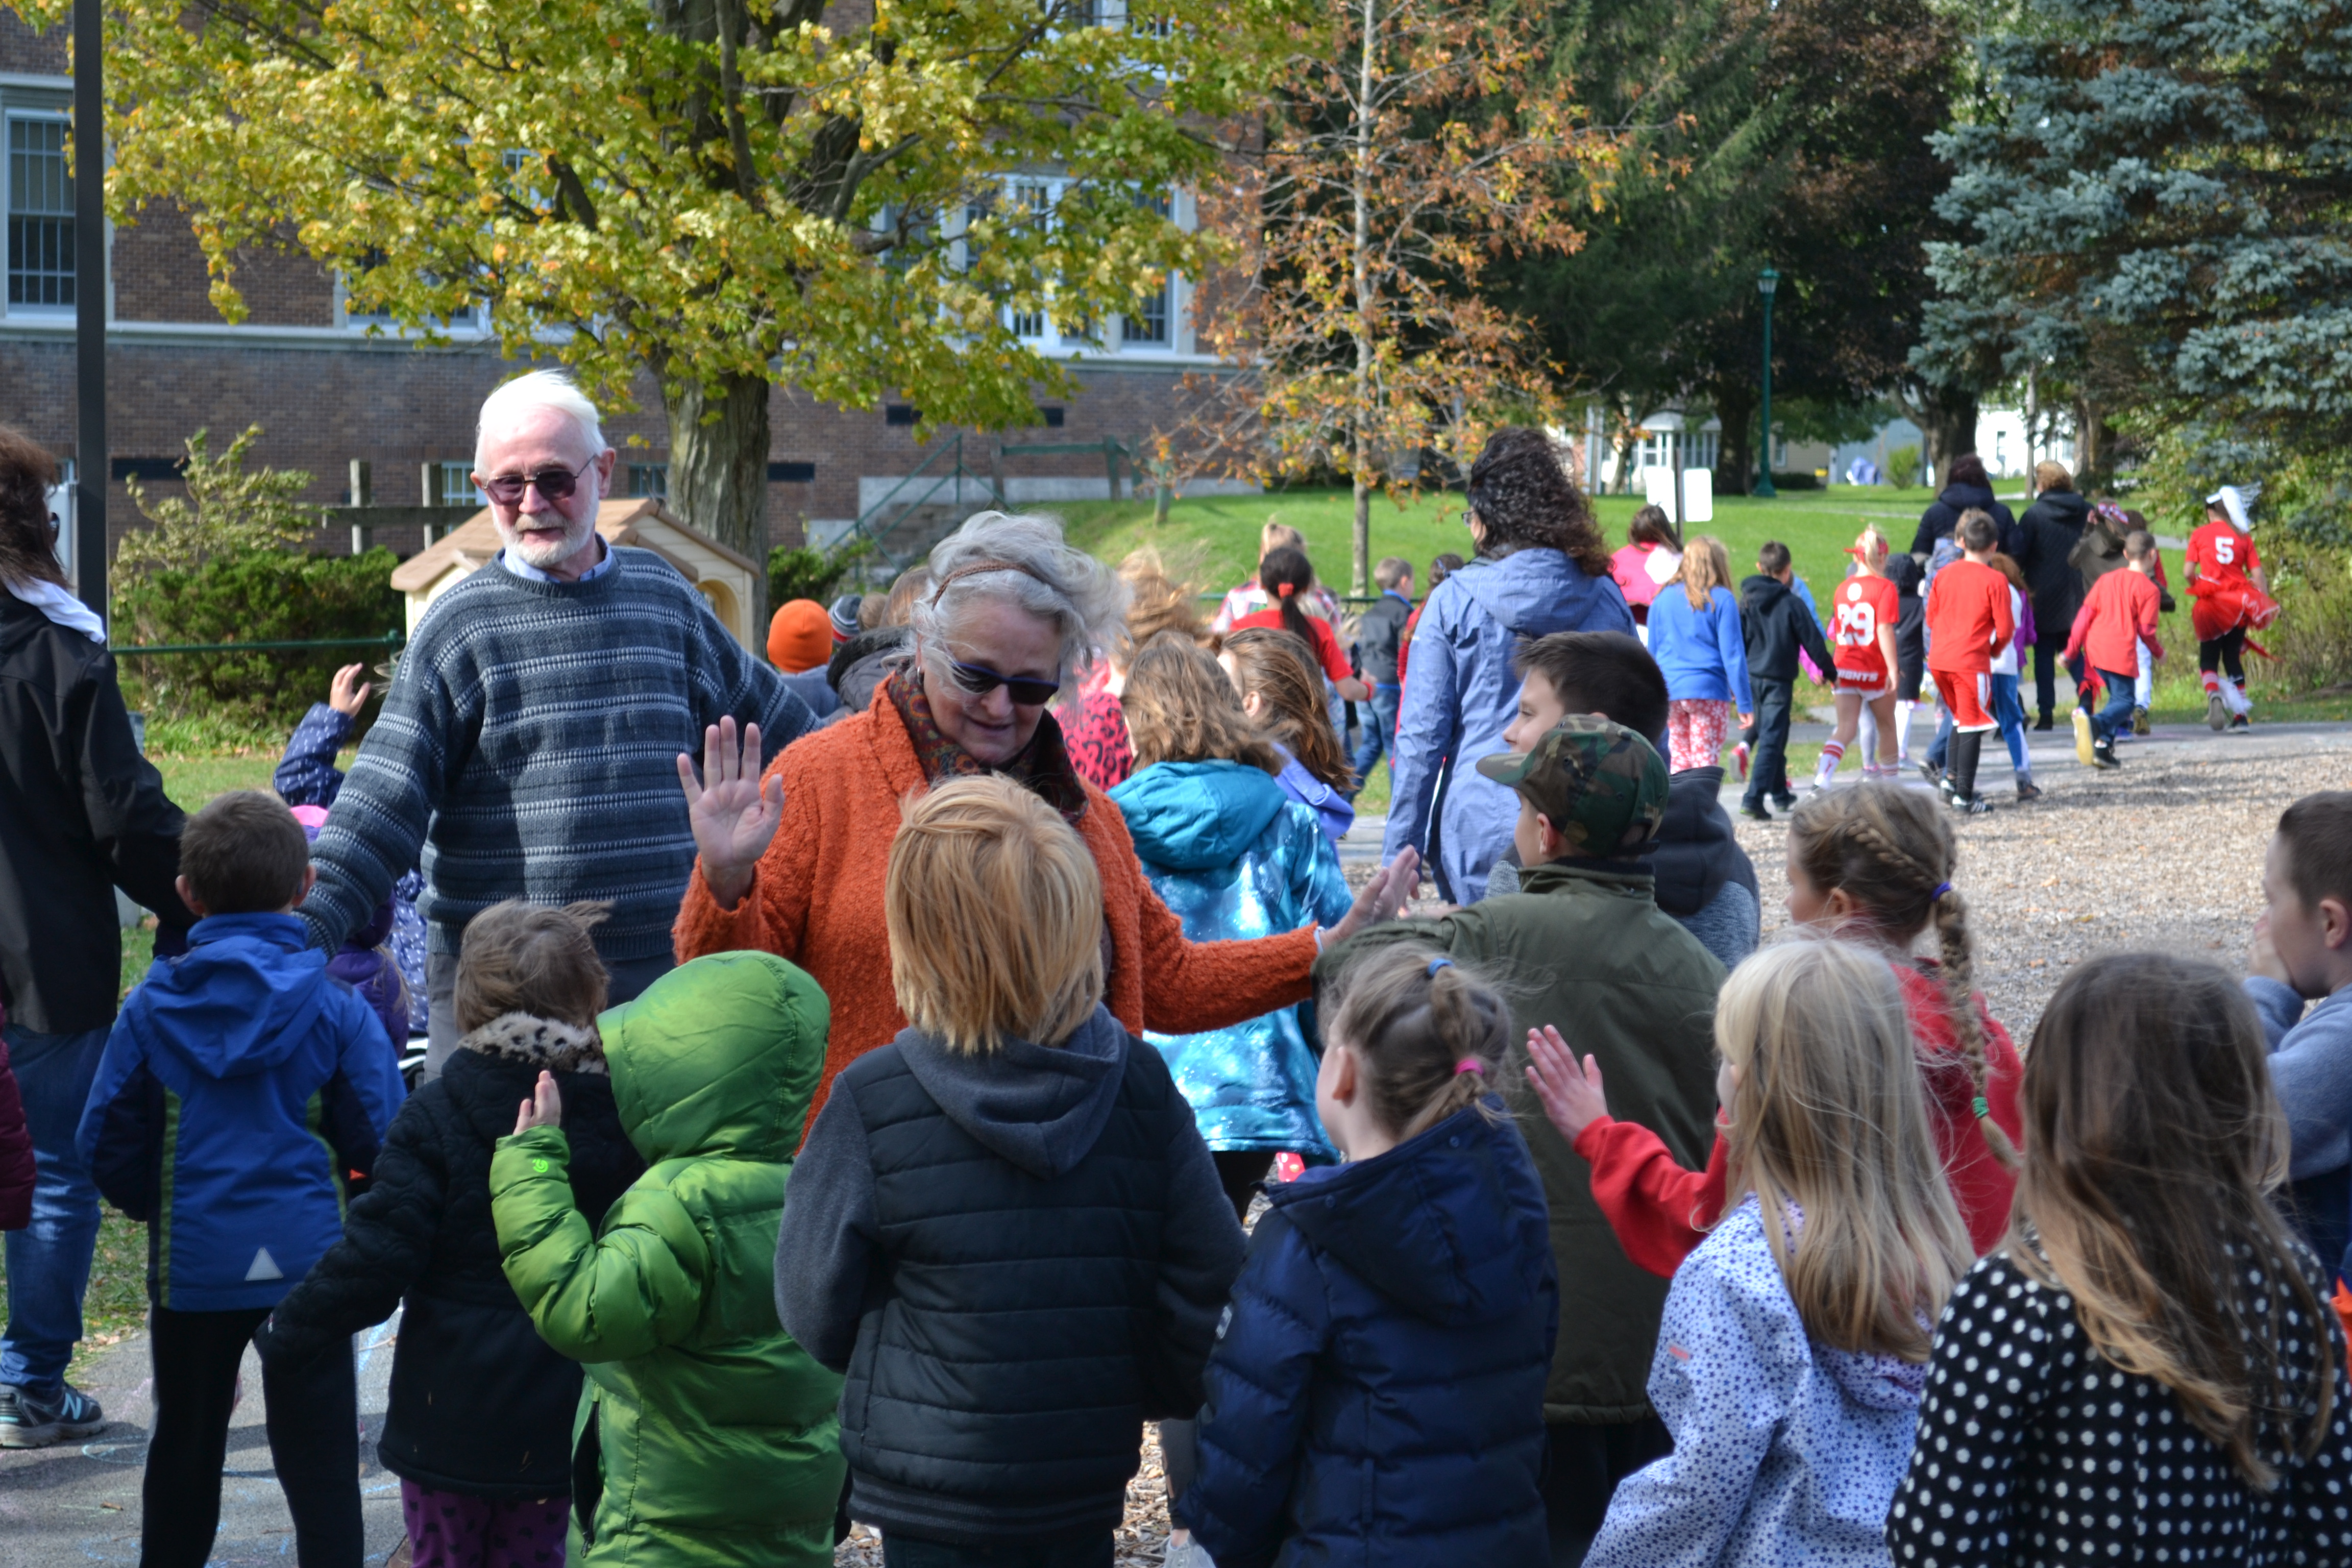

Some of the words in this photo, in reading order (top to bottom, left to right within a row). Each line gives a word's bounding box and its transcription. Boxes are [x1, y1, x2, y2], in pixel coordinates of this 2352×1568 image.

[2215, 537, 2234, 564] 5
[1836, 602, 1875, 646] 29
[61, 1392, 82, 1420] N
